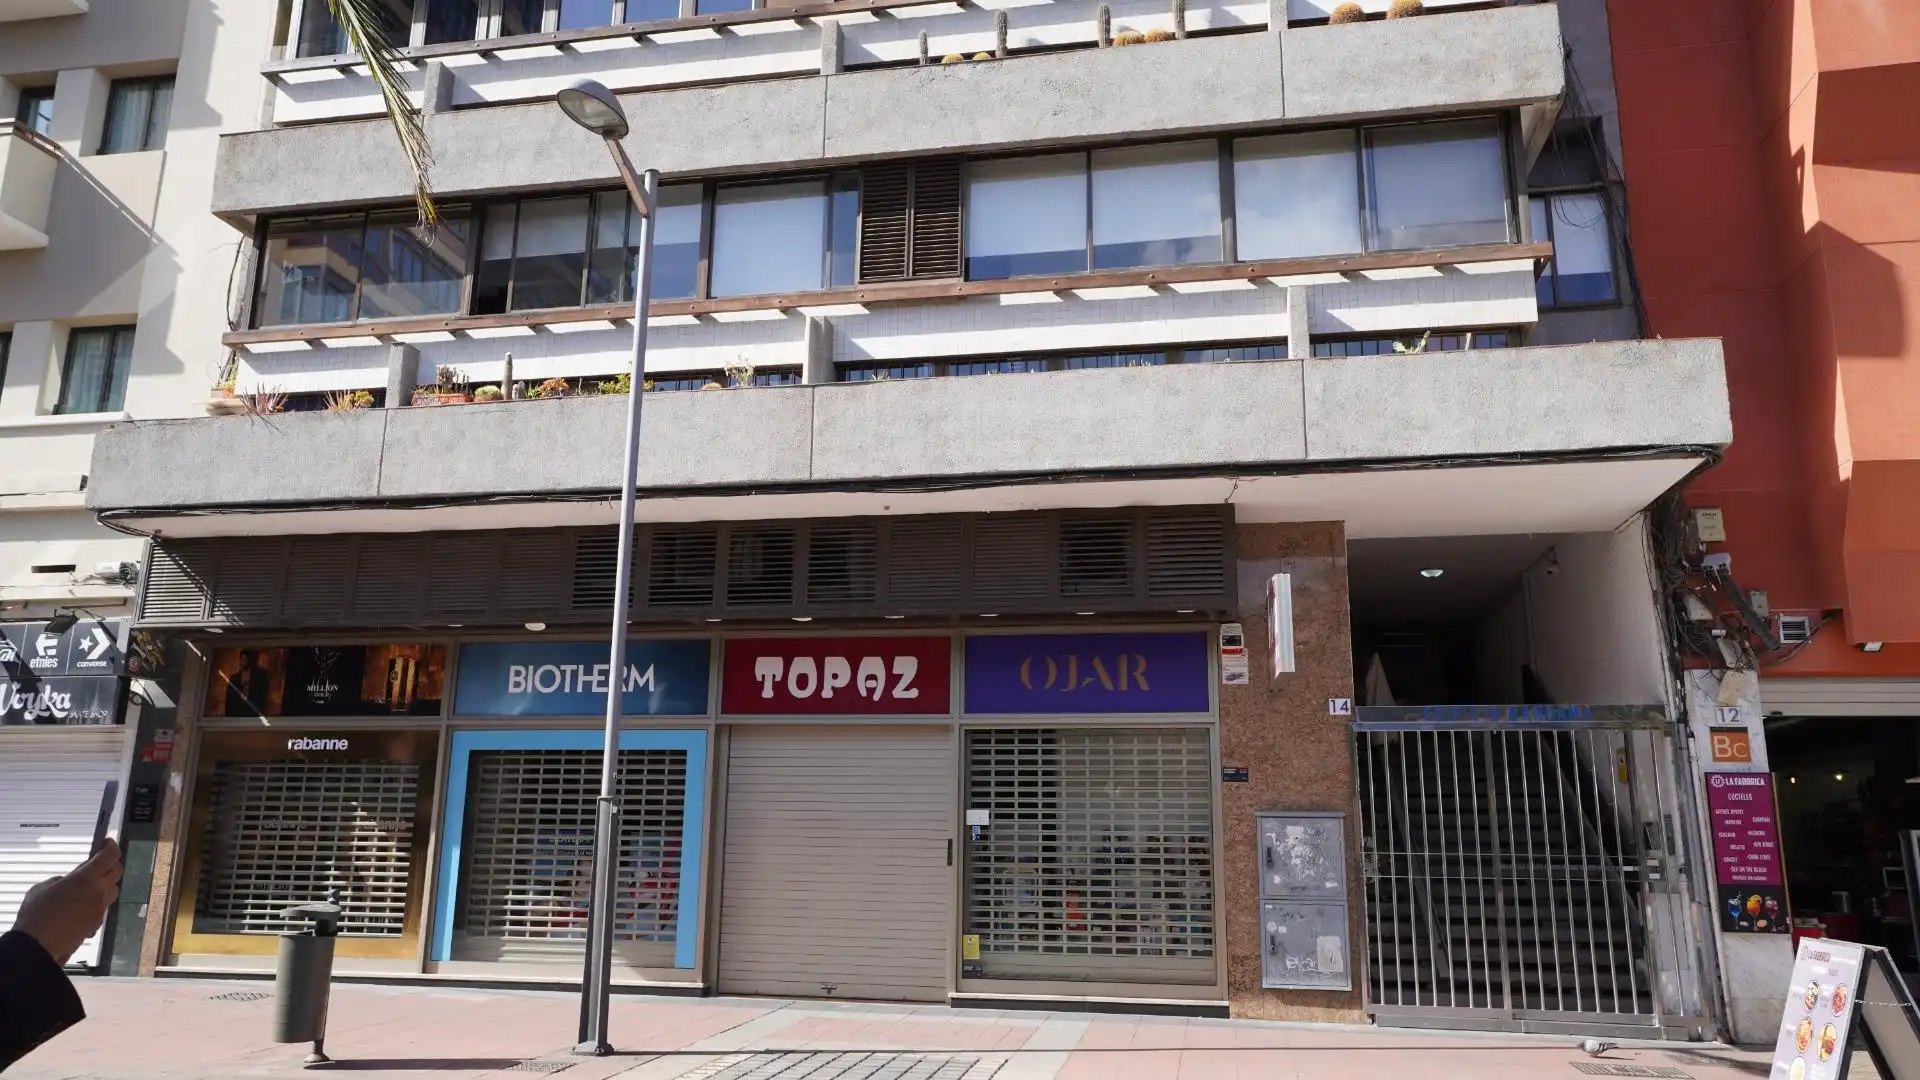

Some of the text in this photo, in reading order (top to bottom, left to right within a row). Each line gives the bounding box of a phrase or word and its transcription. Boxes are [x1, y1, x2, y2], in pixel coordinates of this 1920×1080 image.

[30, 656, 59, 668] etnies
[755, 656, 919, 702] TOPAZ
[1020, 653, 1152, 692] OJAR
[1329, 700, 1350, 713] 14
[1718, 708, 1740, 722] 12
[287, 737, 348, 751] rabanne
[1713, 735, 1748, 758] Bc
[1725, 777, 1735, 786] LA
